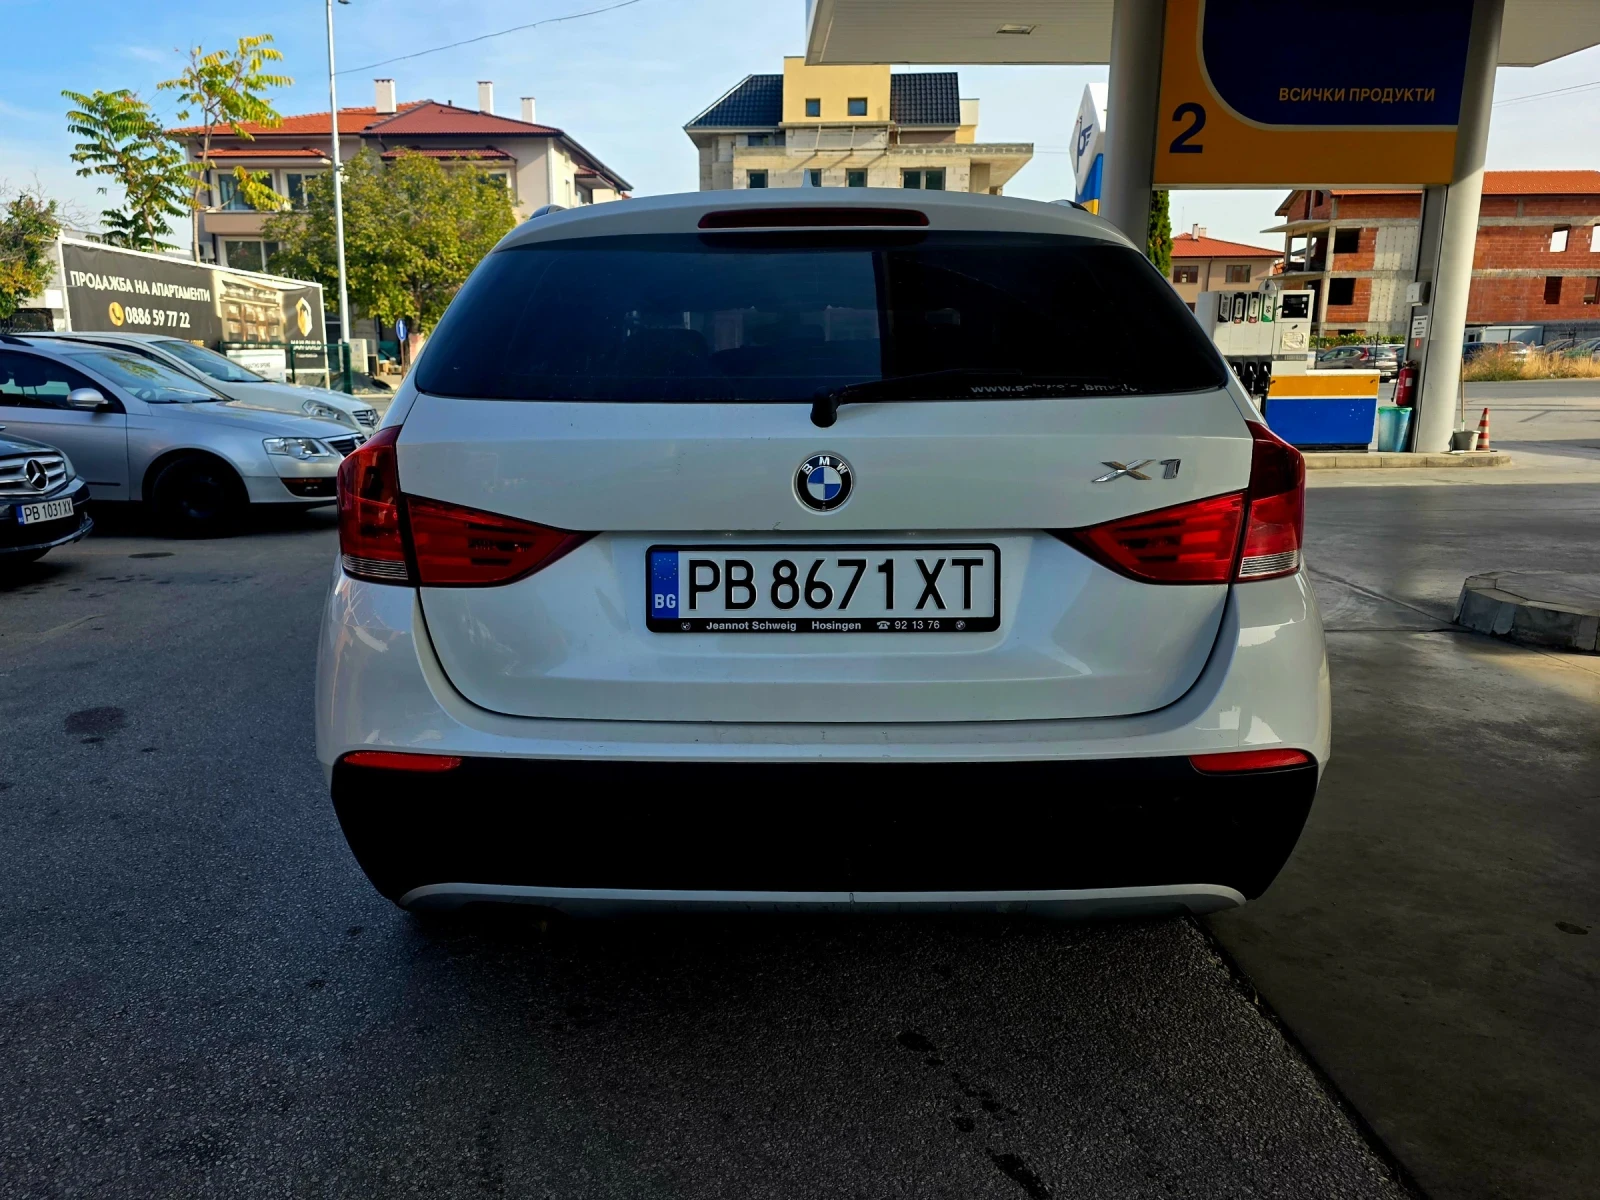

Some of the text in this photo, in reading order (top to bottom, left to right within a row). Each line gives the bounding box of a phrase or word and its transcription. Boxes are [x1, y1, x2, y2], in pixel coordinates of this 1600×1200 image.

[1279, 87, 1436, 104] ВСИЧКИ ПРОДУКТИ
[1169, 102, 1207, 154] 2
[70, 270, 211, 302] ПРОДАЖБА НА АПАРТАМЕНТИ
[125, 306, 191, 328] 0886 59 77 22
[802, 456, 848, 475] BMW
[1091, 459, 1182, 482] X1
[24, 506, 40, 522] PB
[42, 502, 62, 518] 1031
[689, 558, 984, 610] PB 8671 XT
[654, 593, 676, 609] BG
[706, 620, 940, 631] Jeannot Schweig Hosingen 92 13 76
